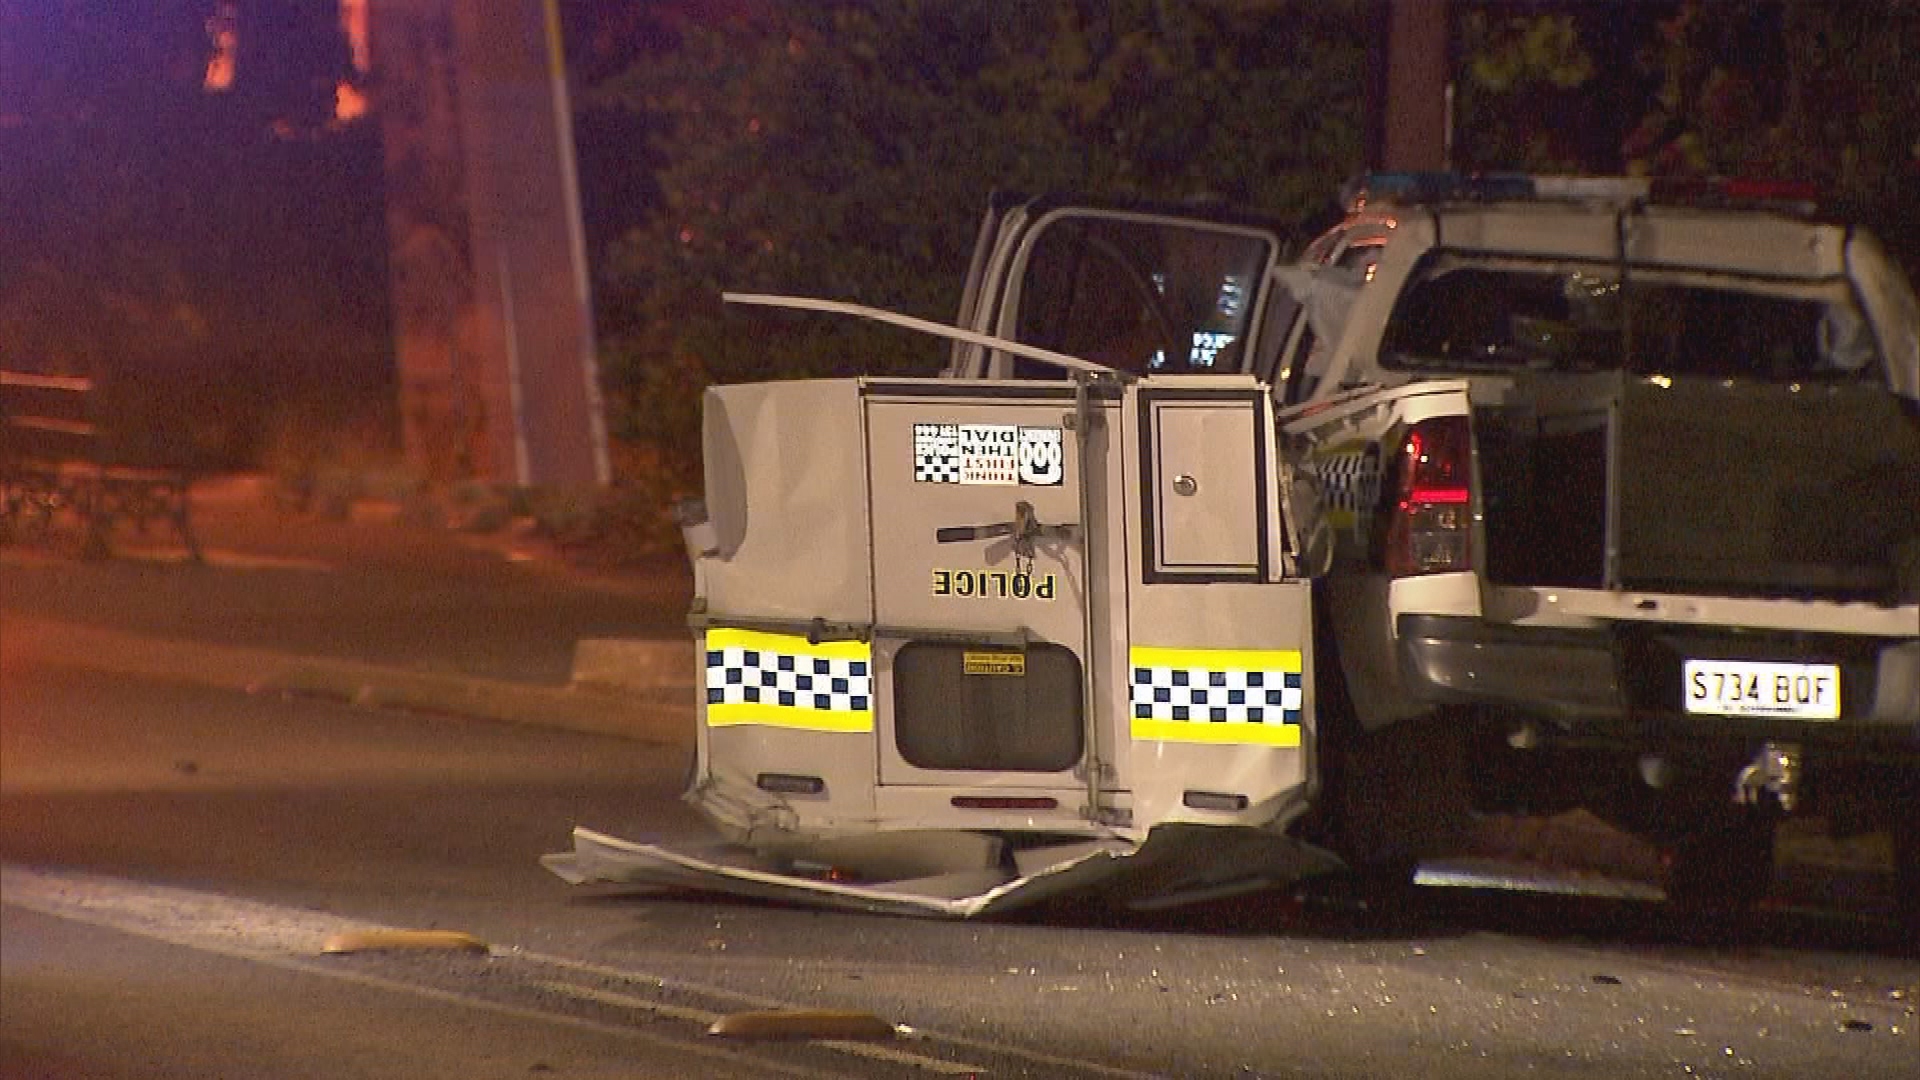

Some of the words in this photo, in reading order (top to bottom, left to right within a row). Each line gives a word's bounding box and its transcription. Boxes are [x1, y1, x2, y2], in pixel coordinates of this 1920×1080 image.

[961, 429, 1015, 443] DIAL
[961, 445, 1014, 457] THEN
[963, 458, 1015, 470] FIRST
[964, 472, 1015, 481] THINK
[933, 571, 1055, 599] POLICE
[1692, 671, 1760, 701] S734
